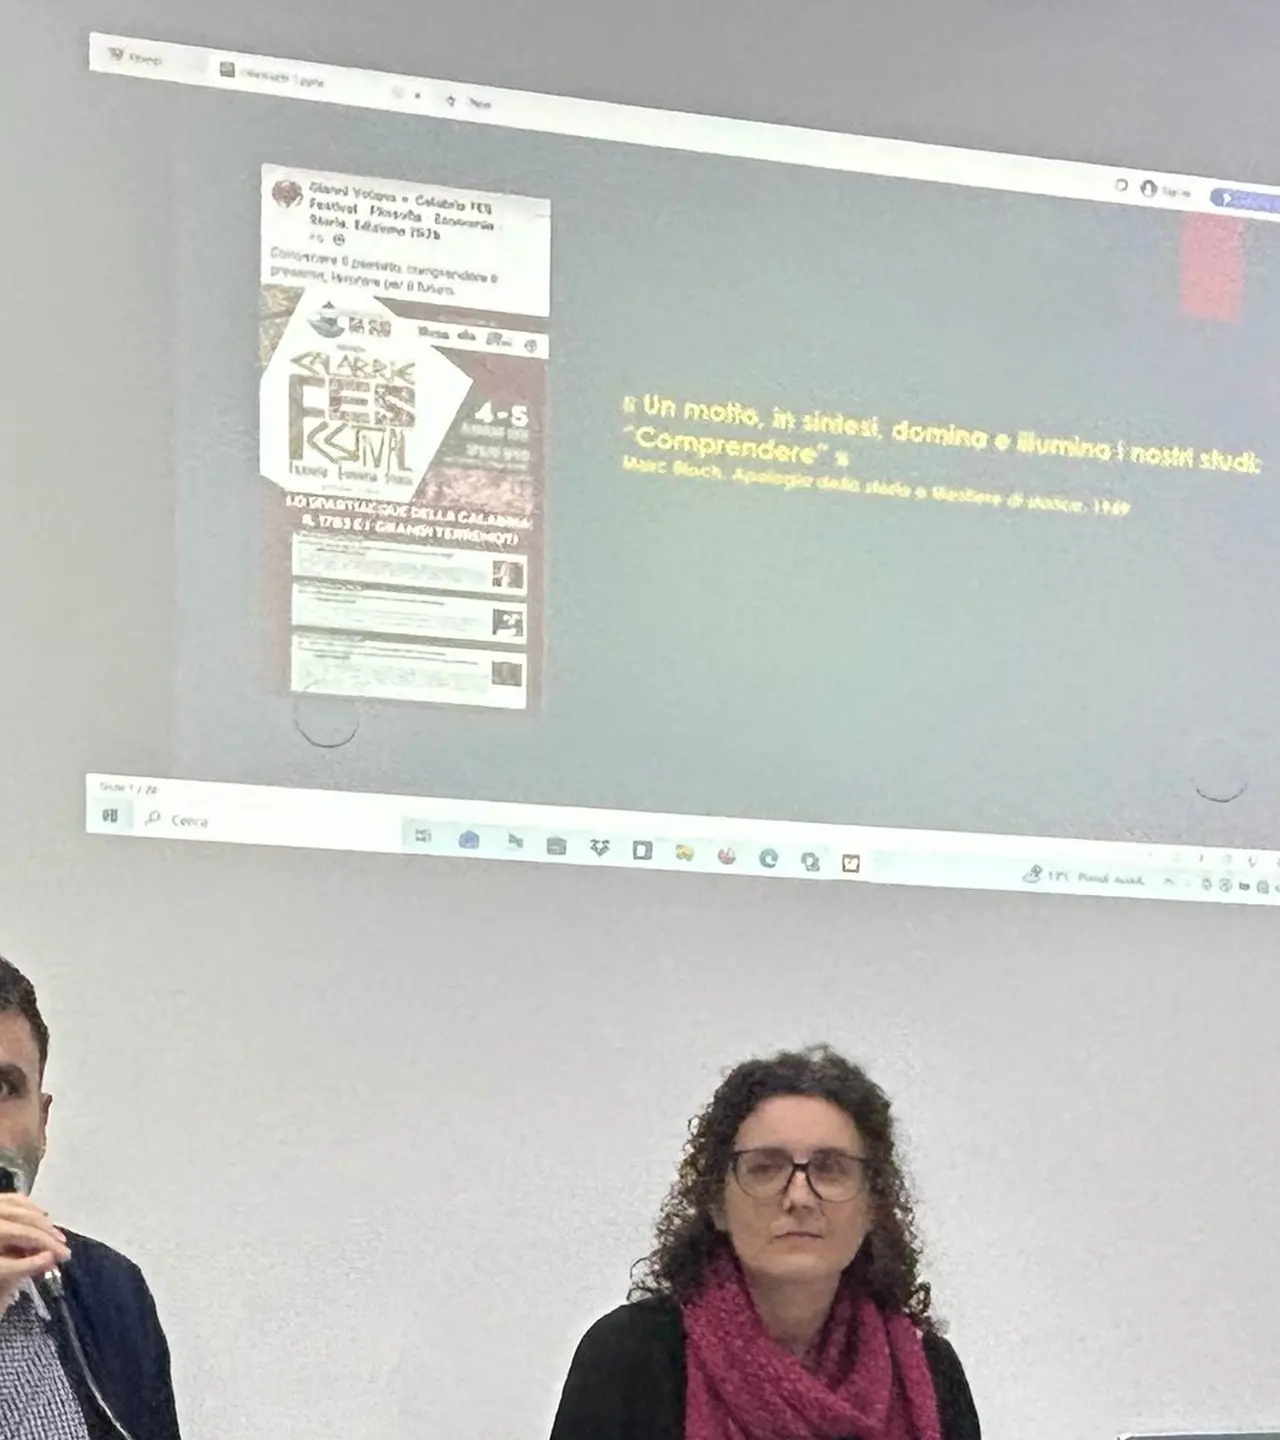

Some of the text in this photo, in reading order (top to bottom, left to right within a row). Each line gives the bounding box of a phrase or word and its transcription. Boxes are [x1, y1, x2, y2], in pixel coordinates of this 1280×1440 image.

[643, 394, 676, 418] Un
[684, 401, 765, 430] motto,
[892, 419, 988, 450] domina
[994, 432, 1010, 451] e
[1016, 430, 1111, 462] illumina
[1131, 444, 1194, 469] nostri
